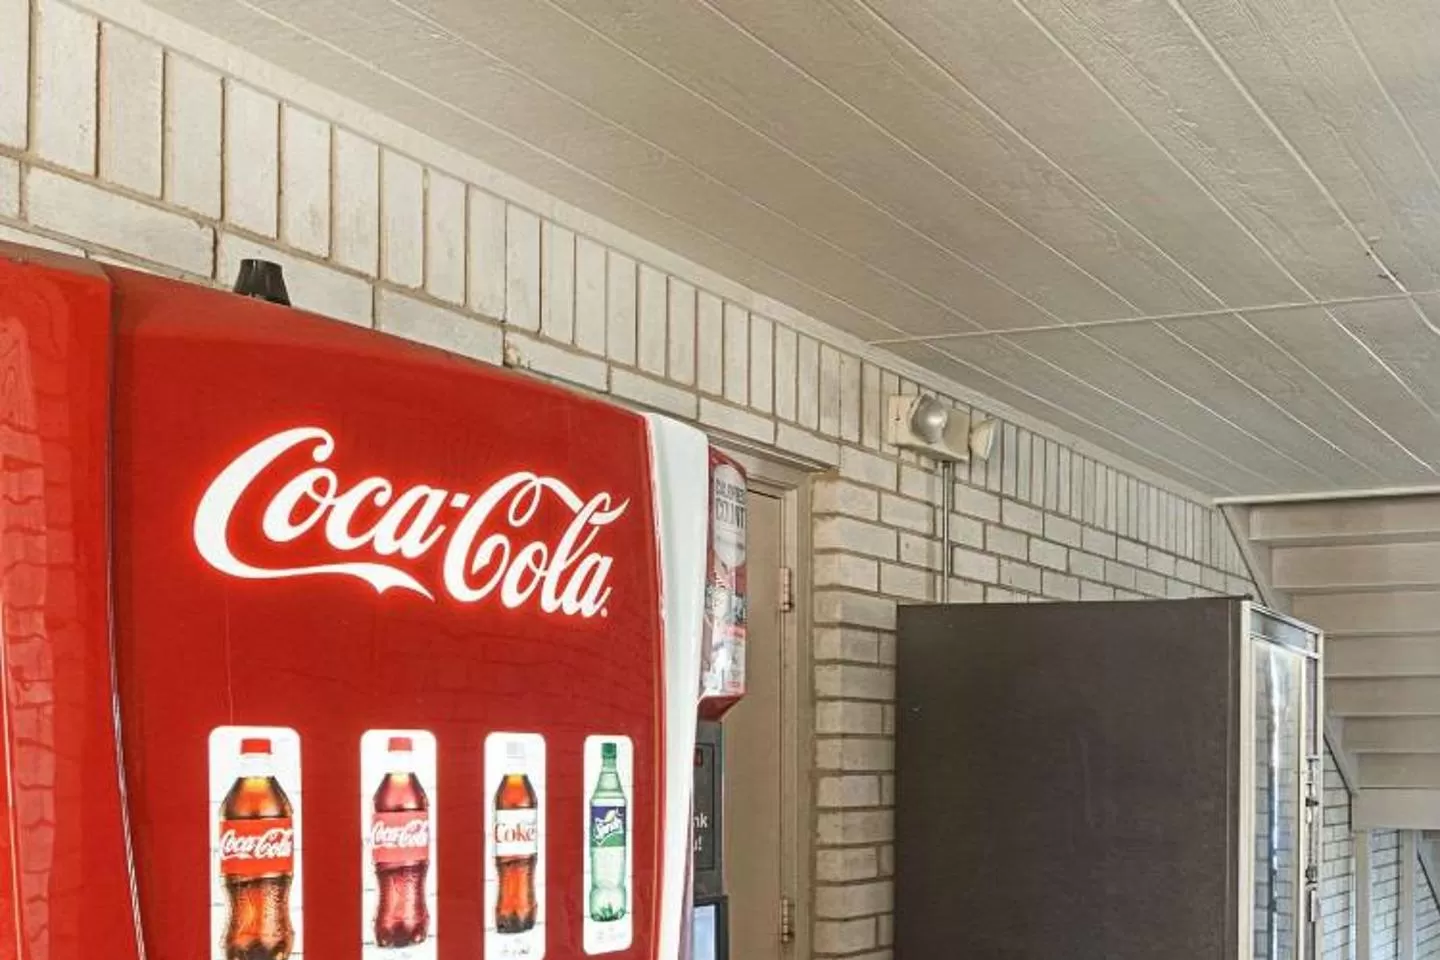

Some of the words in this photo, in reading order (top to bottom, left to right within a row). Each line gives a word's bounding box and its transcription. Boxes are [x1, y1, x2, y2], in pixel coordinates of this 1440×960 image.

[193, 426, 630, 617] Coca-Cola
[221, 827, 293, 859] Coca-Cola
[494, 822, 536, 844] Coke
